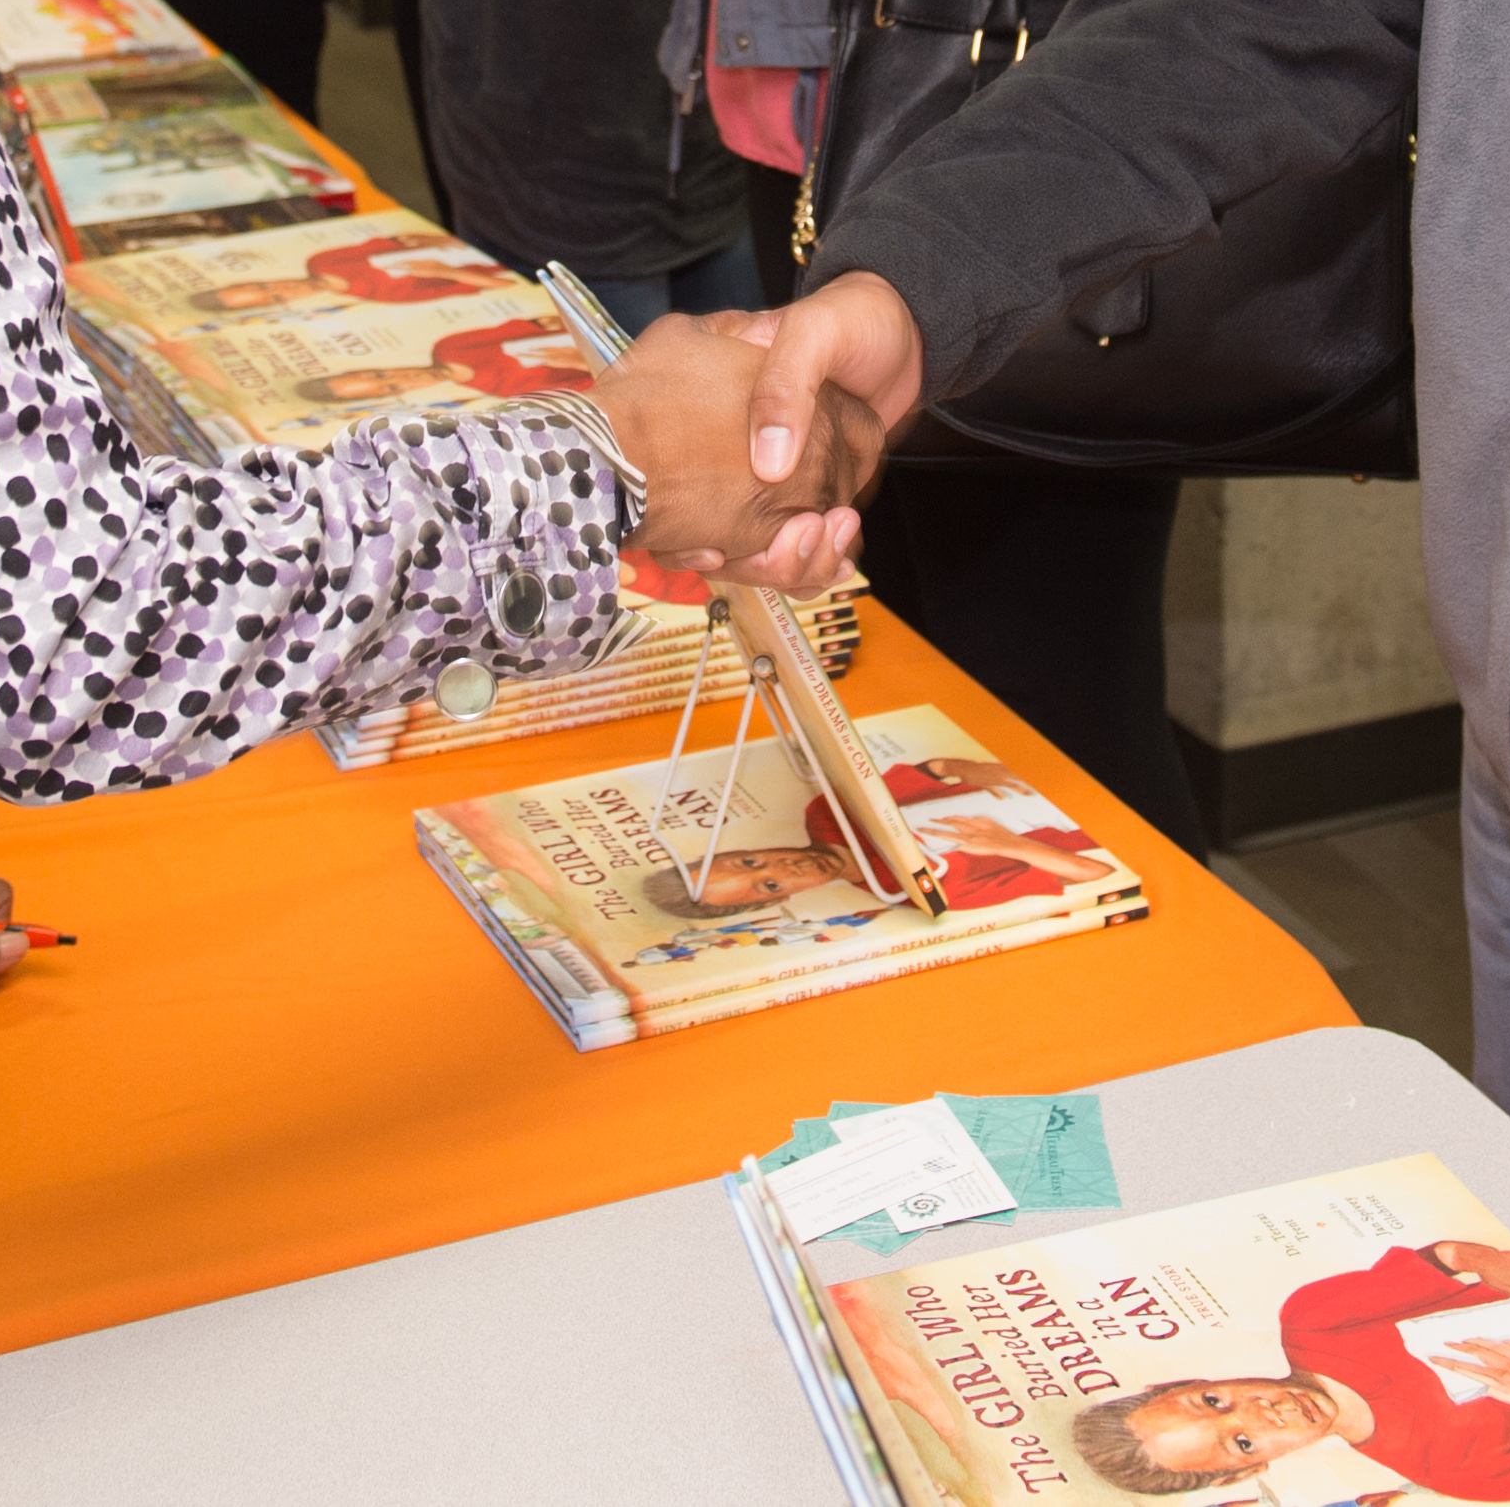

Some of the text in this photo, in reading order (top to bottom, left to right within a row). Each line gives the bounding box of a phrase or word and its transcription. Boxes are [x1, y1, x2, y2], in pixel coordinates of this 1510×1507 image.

[775, 612, 790, 635] Who
[787, 635, 810, 665] Buried
[803, 665, 817, 682] Her
[813, 681, 848, 735] DREAMS
[841, 733, 851, 746] in
[847, 745, 855, 753] a
[851, 750, 875, 781] CAN
[563, 798, 640, 870] Buried Her
[588, 787, 672, 865] DREAMS
[668, 789, 729, 829] CAN
[882, 807, 904, 839] VIKING
[517, 800, 637, 921] The GIRL Who
[759, 976, 777, 986] The
[779, 966, 807, 981] GIRL
[891, 934, 947, 955] DREAMS
[967, 922, 997, 937] CAN
[766, 999, 784, 1010] The
[785, 988, 819, 1005] GIRL
[898, 955, 952, 978] DREAMS
[975, 943, 1004, 959] CAN
[653, 1007, 748, 1036] TRENT GILCHRIST
[1050, 1168, 1065, 1197] TRENT
[1365, 1194, 1405, 1231] Gilchrist
[1252, 1213, 1301, 1258] Dr. Tererai
[1284, 1218, 1309, 1243] Trent
[1344, 1196, 1393, 1238] Jan Spivey
[962, 1283, 1011, 1322] Her
[1077, 1297, 1127, 1340] in a
[1099, 1276, 1180, 1340] CAN
[1158, 1263, 1224, 1329] A TRUE STORY
[982, 1326, 1068, 1401] Buried
[995, 1269, 1121, 1396] DREAMS
[905, 1285, 1068, 1494] The GIRL Who
